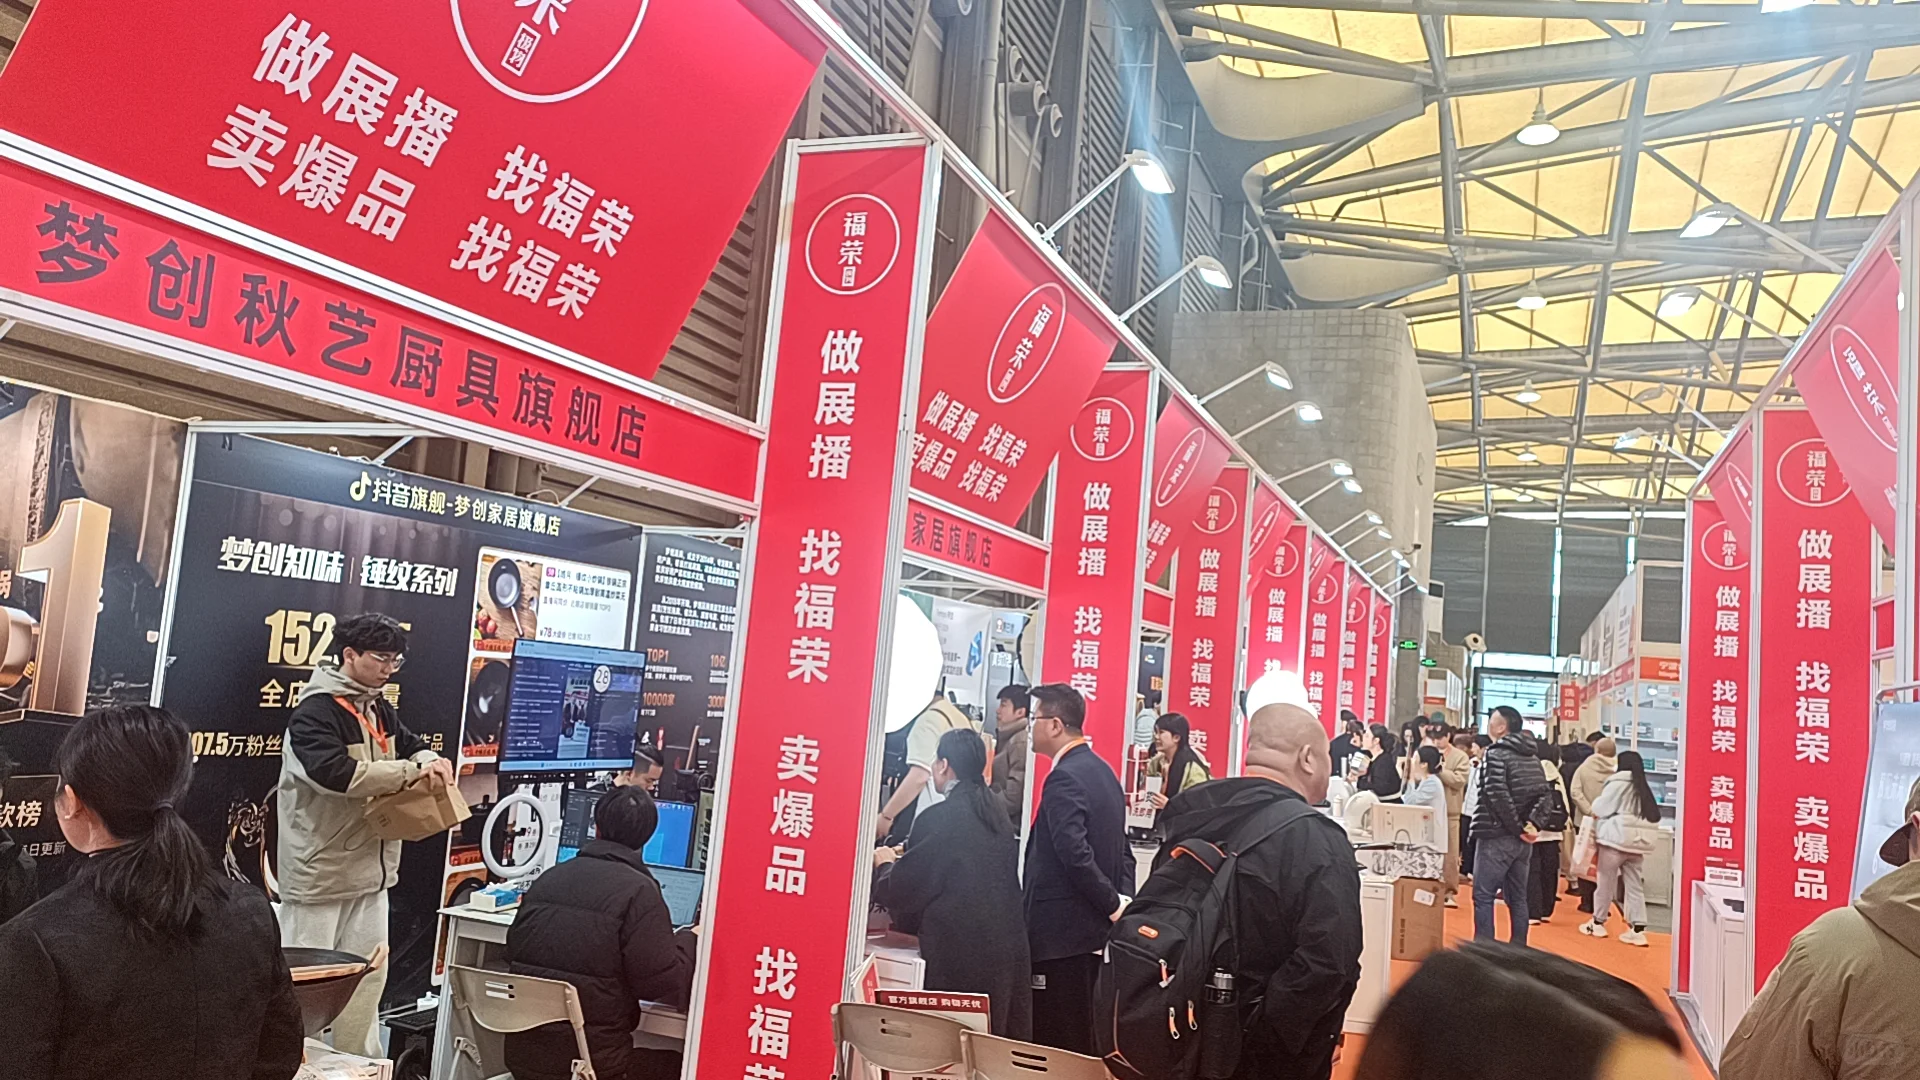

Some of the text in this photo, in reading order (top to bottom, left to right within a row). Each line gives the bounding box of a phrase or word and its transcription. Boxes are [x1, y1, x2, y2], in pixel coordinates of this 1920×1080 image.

[252, 12, 635, 258] 做展播 找福荣
[206, 103, 602, 320] 卖爆品 找福荣
[839, 211, 868, 266] 福荣
[35, 200, 647, 459] 梦创秋艺厨具旗舰店
[1008, 303, 1054, 371] 福荣
[808, 329, 863, 480] 做展播
[922, 390, 1028, 469] 做展播 找福荣
[1093, 408, 1112, 444] 福荣
[911, 431, 1009, 503] 卖爆品 找福荣
[1804, 450, 1828, 488] 福荣
[372, 477, 562, 538] 抖音旗舰-梦创家居旗舰店
[910, 511, 994, 569] 家居旗舰店
[217, 535, 459, 598] 梦创知味 锤纹系列
[1070, 482, 1111, 702] 做展播 找福荣
[1195, 548, 1222, 619] 做展播
[786, 529, 843, 684] 找福荣
[1265, 588, 1287, 644] 做展播
[1713, 585, 1741, 659] 做展播
[596, 670, 609, 685] 28
[647, 648, 669, 663] TOP1
[1189, 638, 1215, 708] 找福荣
[1711, 679, 1739, 754] 找福荣
[1793, 529, 1833, 901] 做展播 找福荣 卖爆品
[765, 734, 821, 896] 卖爆品
[1708, 774, 1736, 851] 卖爆品
[888, 996, 938, 1006] 官方旗舰店
